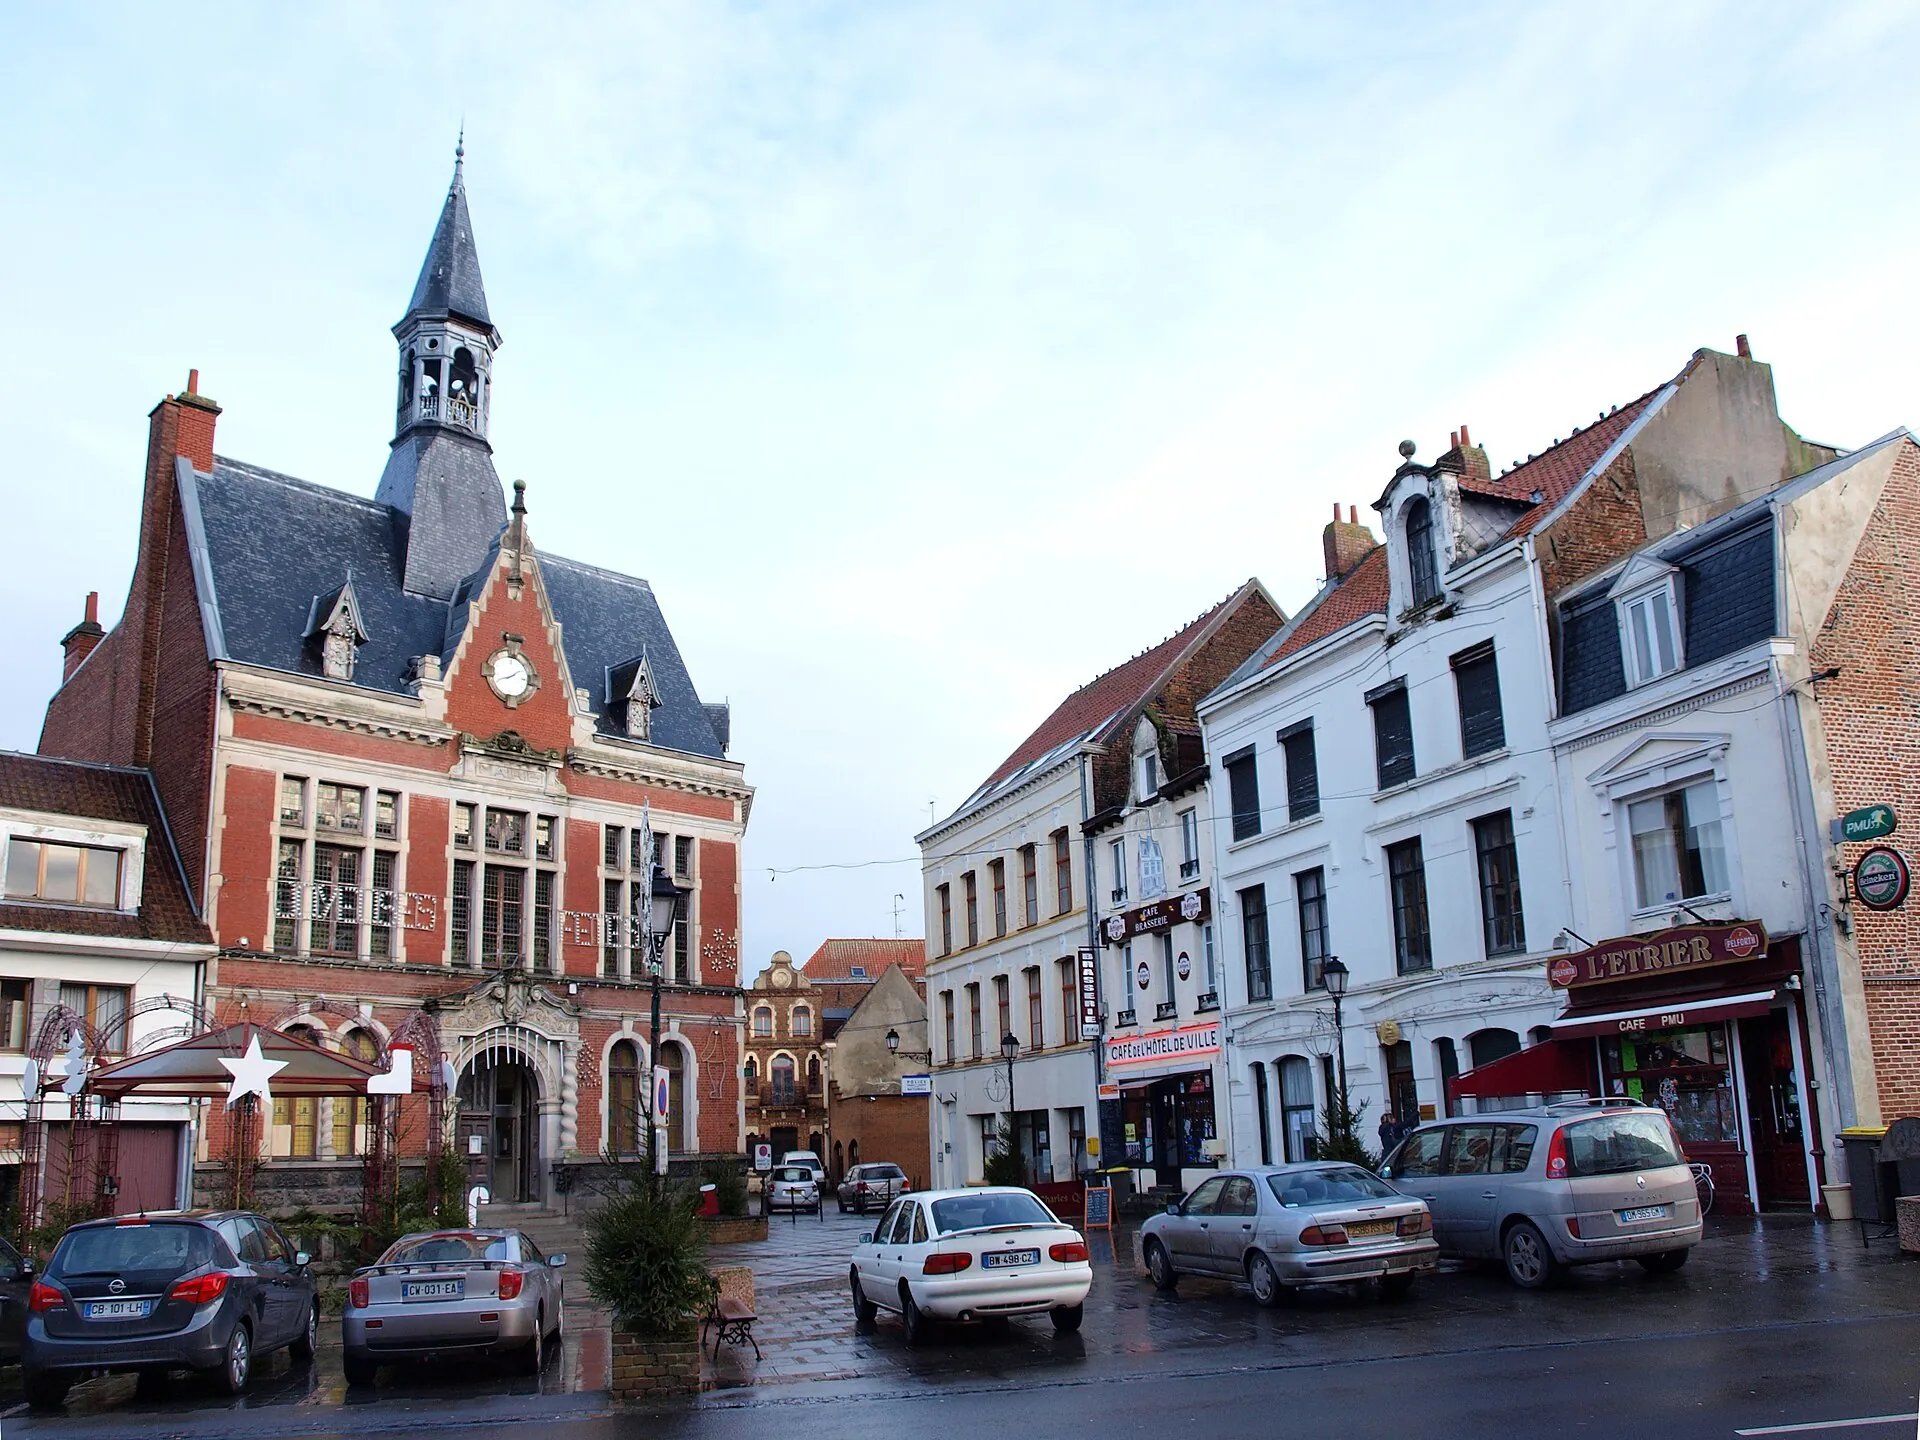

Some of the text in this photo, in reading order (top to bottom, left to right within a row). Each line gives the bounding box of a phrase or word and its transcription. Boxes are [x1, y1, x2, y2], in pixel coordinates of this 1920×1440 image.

[1846, 818, 1871, 834] PMU
[1859, 872, 1896, 886] Heineken
[1135, 915, 1169, 932] BRASSERIE
[1726, 934, 1757, 949] PELFORTH
[1586, 935, 1713, 980] L'ETRIER
[1551, 965, 1576, 978] PELFORTH
[1081, 952, 1097, 1024] BRASSERIE
[1618, 1013, 1685, 1031] CAFE PMU
[1174, 1037, 1185, 1051] DE
[1187, 1030, 1217, 1049] VILLE
